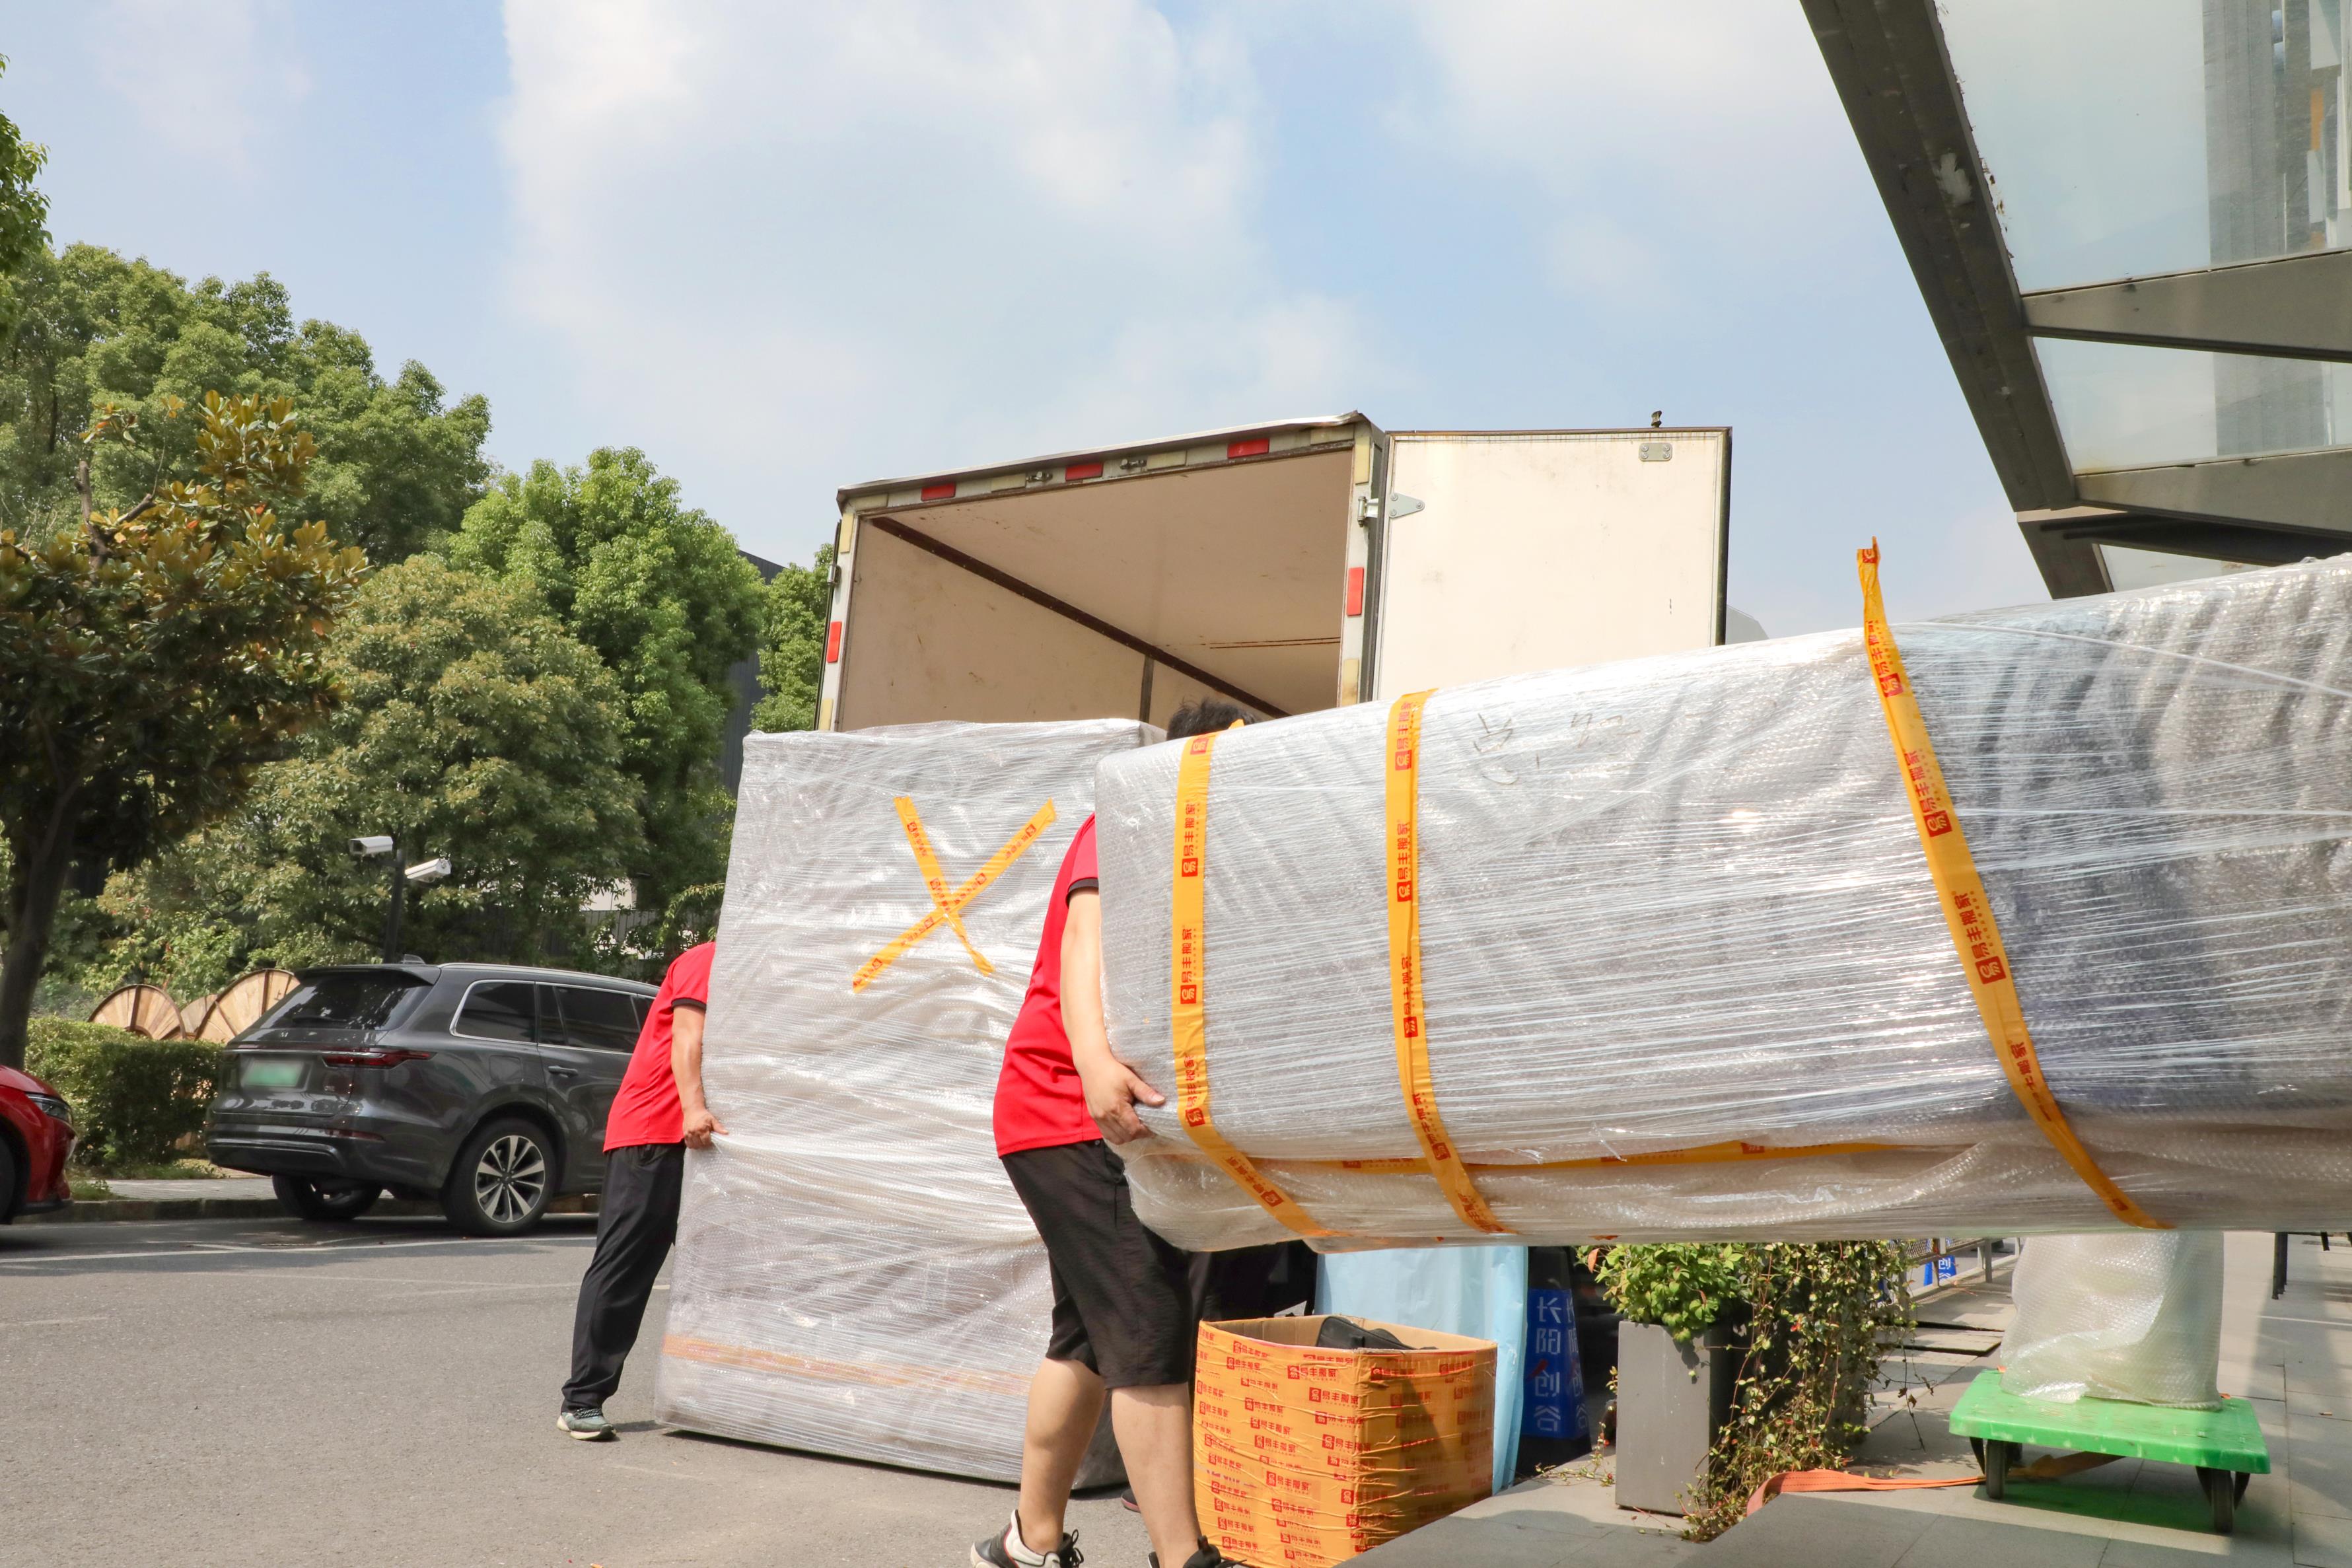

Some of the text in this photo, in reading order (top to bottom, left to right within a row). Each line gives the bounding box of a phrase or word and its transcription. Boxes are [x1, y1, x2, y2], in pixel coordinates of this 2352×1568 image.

[1904, 750, 1937, 813] 易丰搬家
[1184, 803, 1195, 856] 易丰搬家
[1398, 823, 1409, 879] 易丰搬家
[1954, 893, 1990, 959] 易丰搬家
[1182, 929, 1192, 983] 易丰搬家
